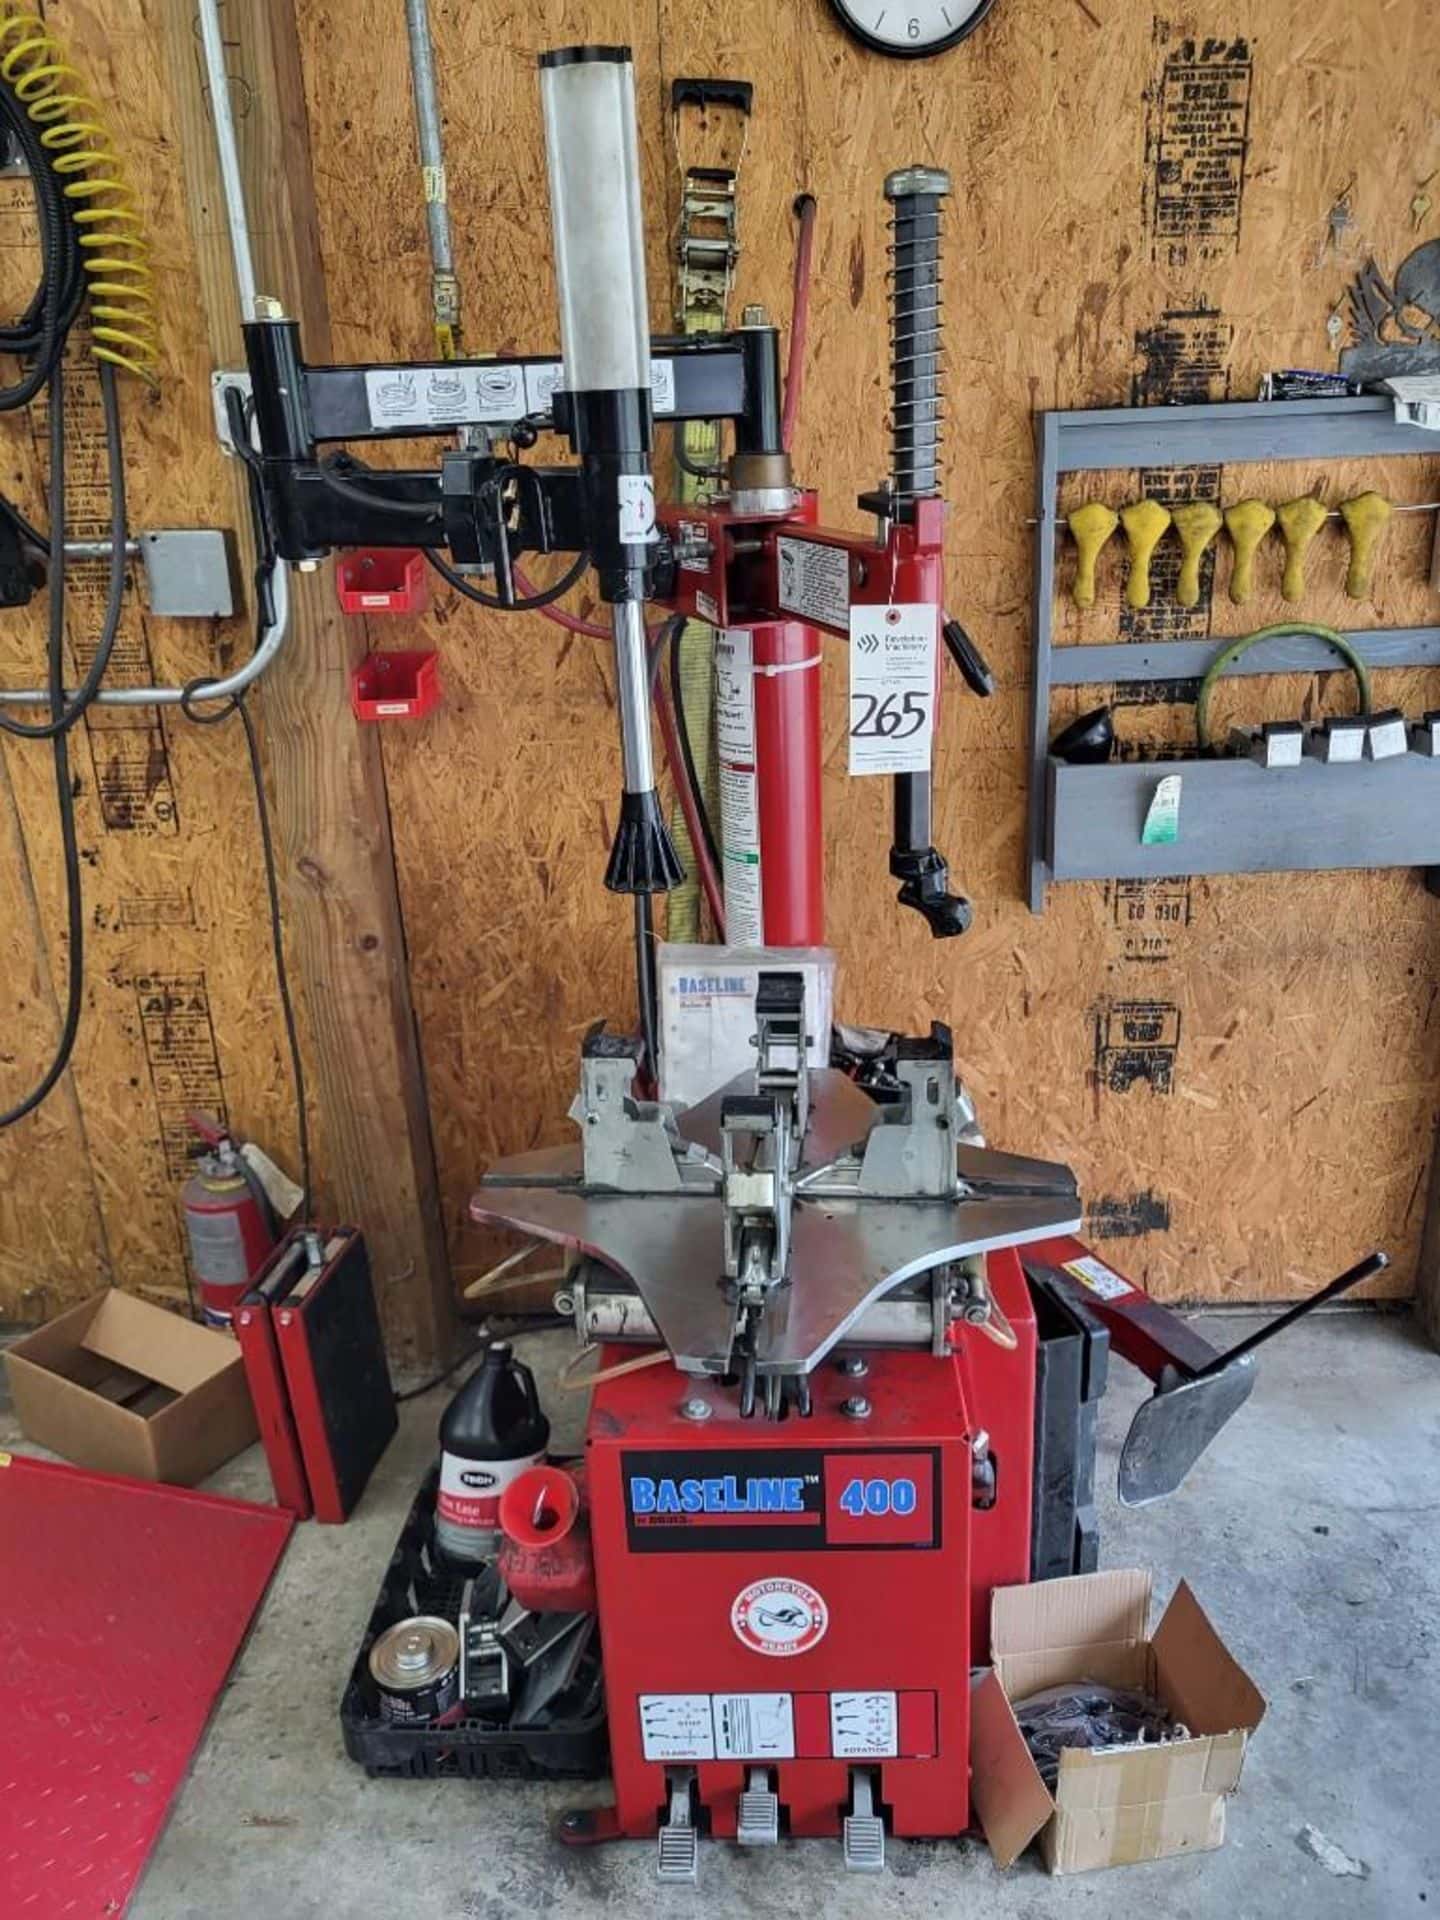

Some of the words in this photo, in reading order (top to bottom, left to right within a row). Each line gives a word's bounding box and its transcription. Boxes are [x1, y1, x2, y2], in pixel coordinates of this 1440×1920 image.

[907, 18, 920, 39] 6
[850, 691, 929, 739] 265
[679, 977, 745, 992] BASELINE
[840, 1479, 917, 1516] 400
[745, 1583, 815, 1604] MOTORCYCLE
